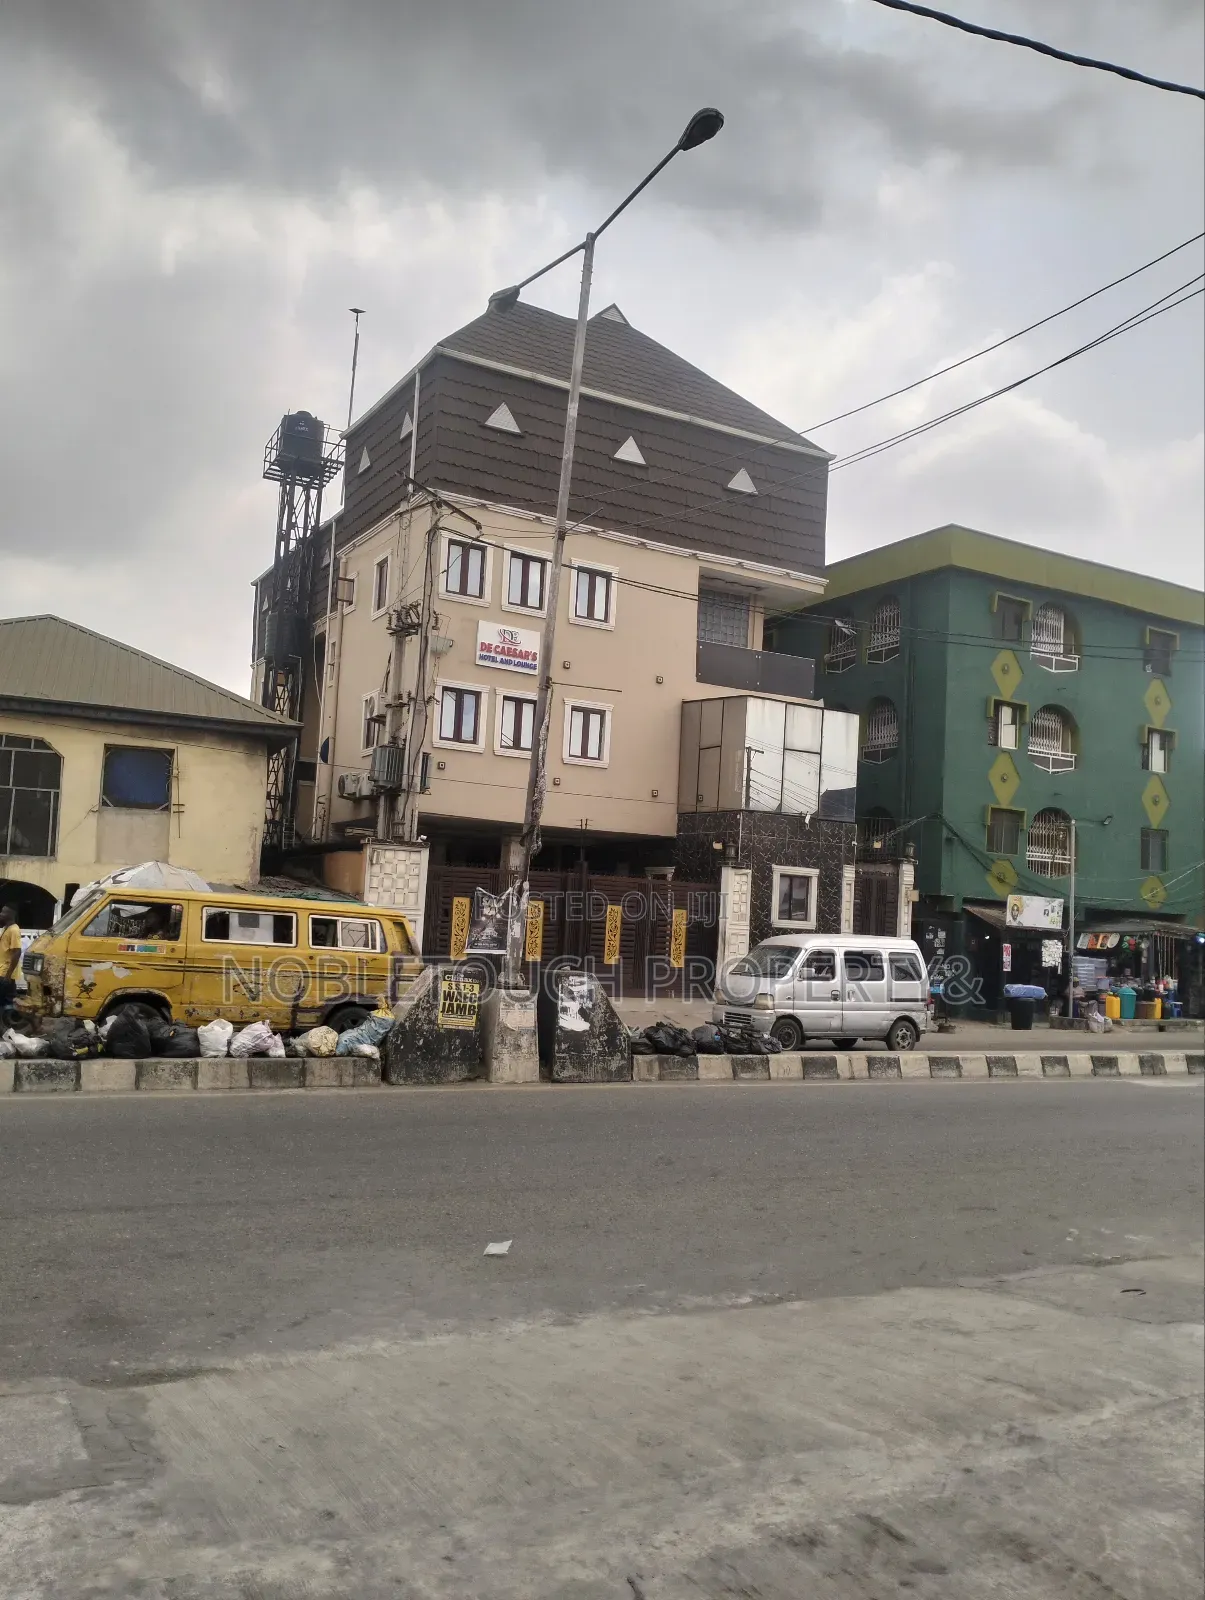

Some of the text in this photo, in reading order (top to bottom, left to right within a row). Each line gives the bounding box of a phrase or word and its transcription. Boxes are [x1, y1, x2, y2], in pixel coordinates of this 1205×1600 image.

[480, 642, 537, 661] DE CAESAR'S
[479, 654, 498, 663] HOTEL
[513, 660, 537, 670] LOUNGE
[443, 990, 477, 1004] WAEC
[441, 1002, 477, 1015] JAMB
